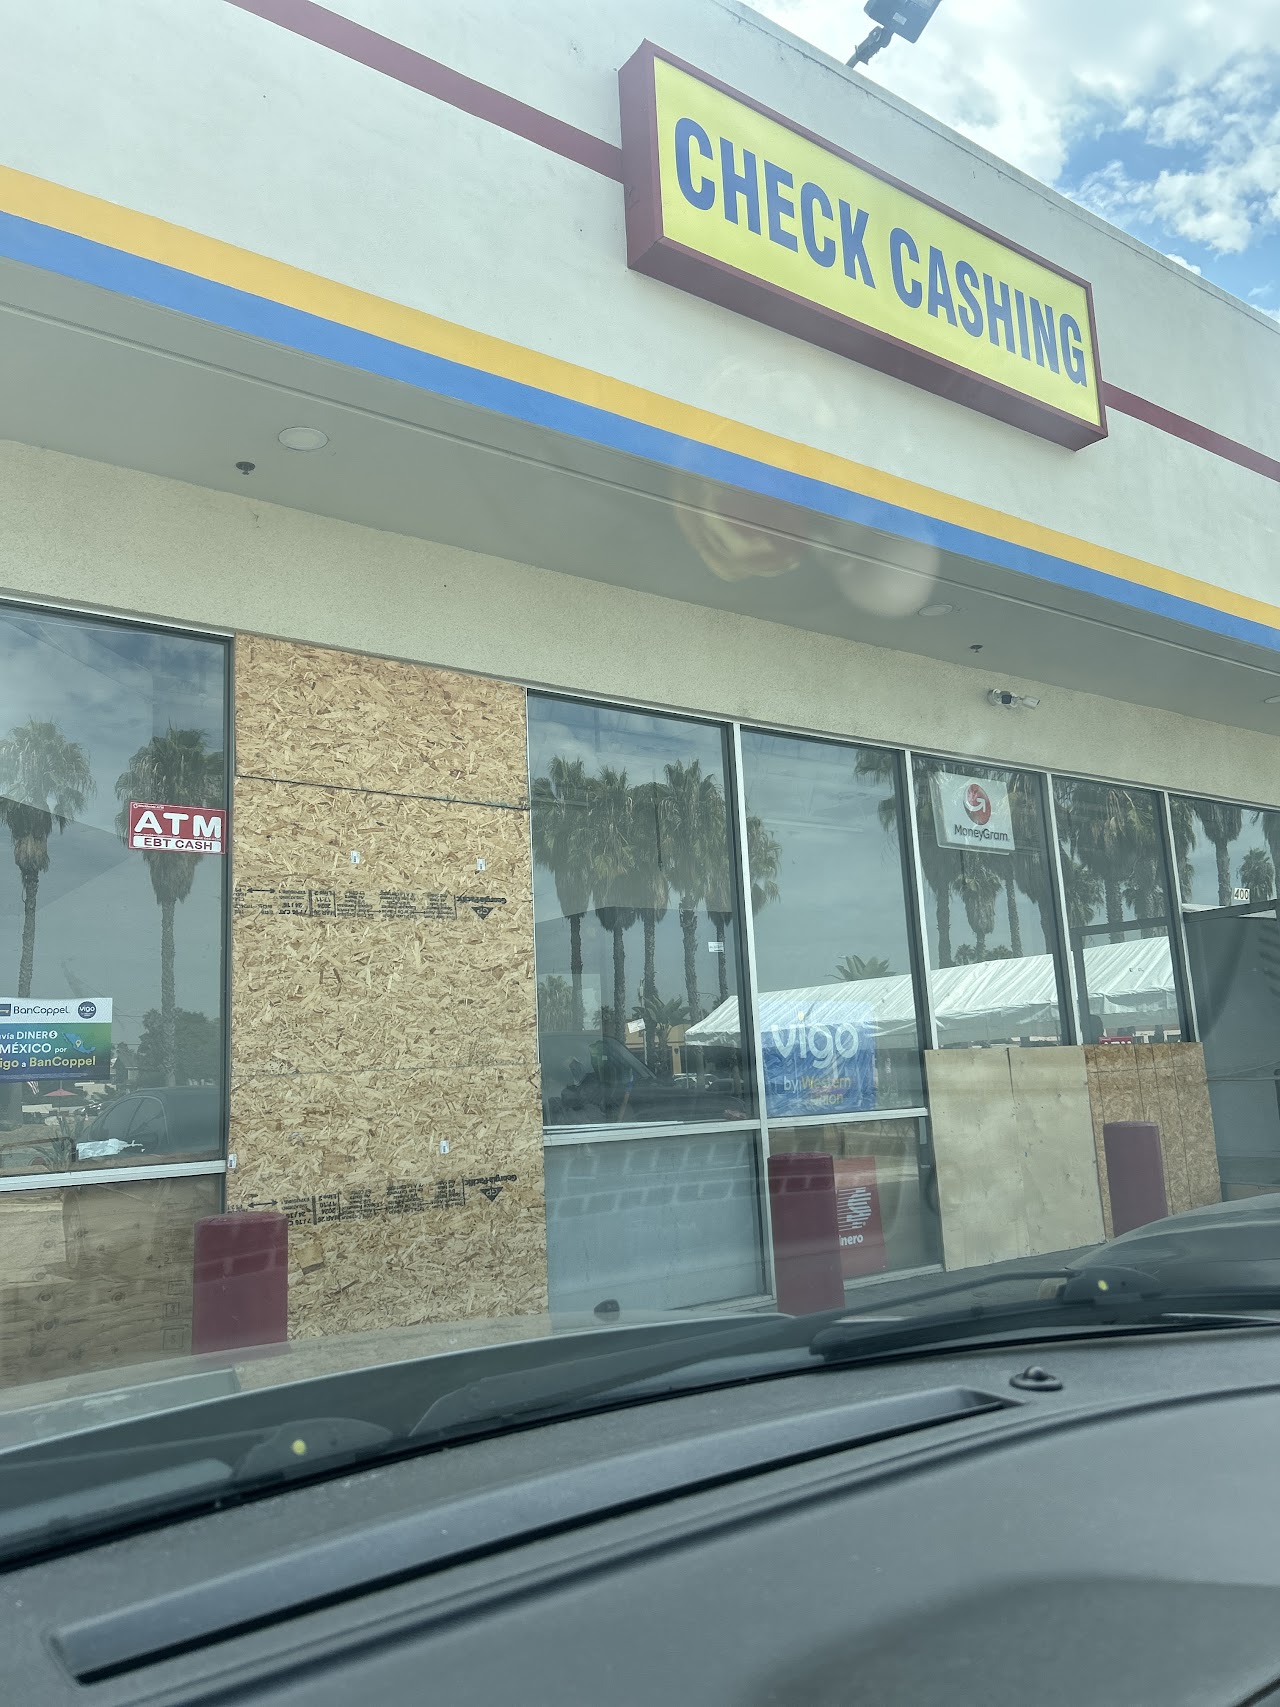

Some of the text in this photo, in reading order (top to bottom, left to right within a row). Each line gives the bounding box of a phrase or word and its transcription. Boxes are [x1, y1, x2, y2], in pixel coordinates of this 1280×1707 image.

[674, 117, 1088, 387] CHECK CASHING
[134, 810, 222, 838] ATM
[954, 824, 1009, 841] MoneyGram
[144, 838, 213, 850] EBT CASH
[1234, 888, 1249, 900] 400
[13, 1005, 69, 1016] BanCoppel
[771, 1011, 858, 1069] vigo
[0, 1042, 52, 1054] MÉXICO
[29, 1056, 96, 1068] BanCoppel
[783, 1076, 798, 1093] by
